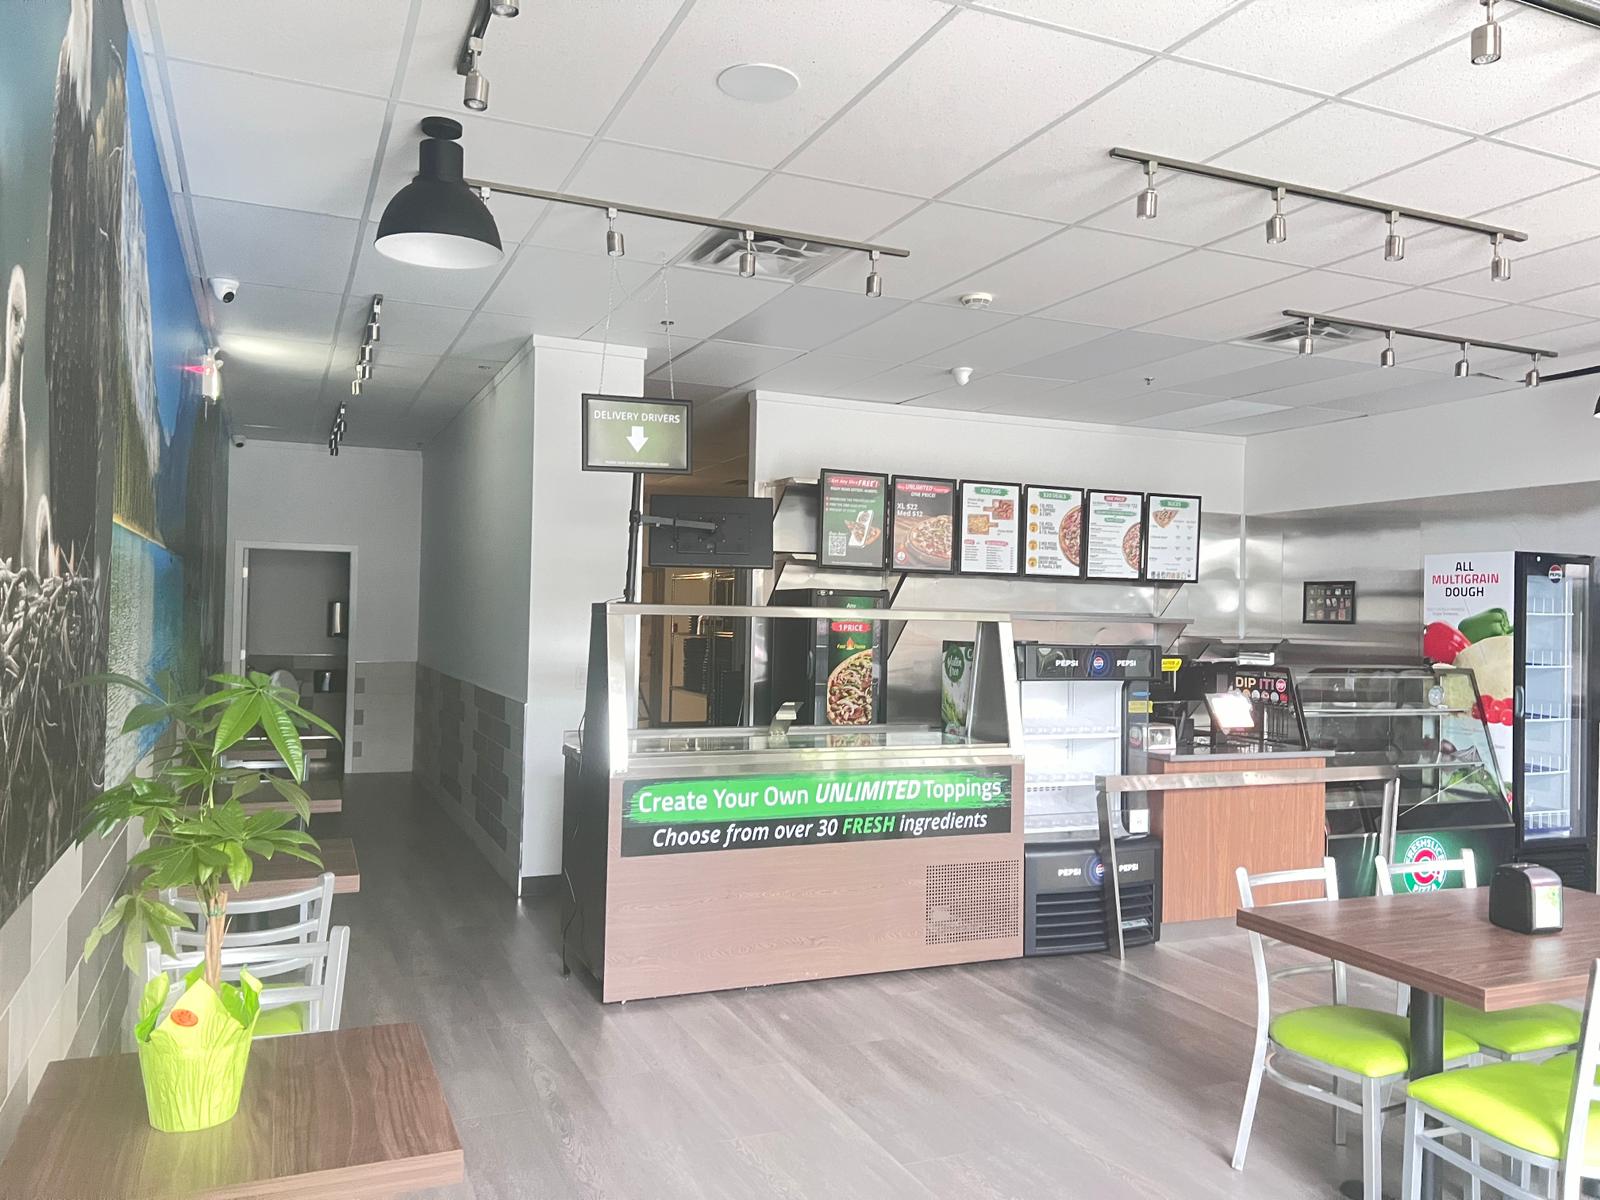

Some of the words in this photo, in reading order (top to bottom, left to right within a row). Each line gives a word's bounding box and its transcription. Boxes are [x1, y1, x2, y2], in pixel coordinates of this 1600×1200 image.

[594, 410, 638, 421] DELIVERY
[642, 413, 680, 423] DRIVERS
[896, 502, 905, 510] XL
[1455, 561, 1474, 572] ALL
[1432, 573, 1499, 585] MULTIGRAIN
[1445, 586, 1485, 597] DOUGH
[843, 624, 864, 632] PRICE
[1055, 659, 1079, 667] PEPSI
[1117, 659, 1137, 667] PEPSI
[1235, 676, 1257, 689] DIP
[638, 791, 708, 814] Create
[712, 787, 760, 809] Your
[763, 784, 810, 808] Own
[815, 779, 921, 804] UNLIMITED
[923, 776, 1002, 802] Toppings
[652, 826, 720, 849] Choose
[722, 822, 769, 848] from
[774, 824, 814, 840] over
[816, 819, 839, 838] 30
[842, 816, 896, 836] FRESH
[898, 812, 988, 837] ingredients
[1057, 868, 1082, 877] PEPSI
[1118, 863, 1139, 872] PEPSI
